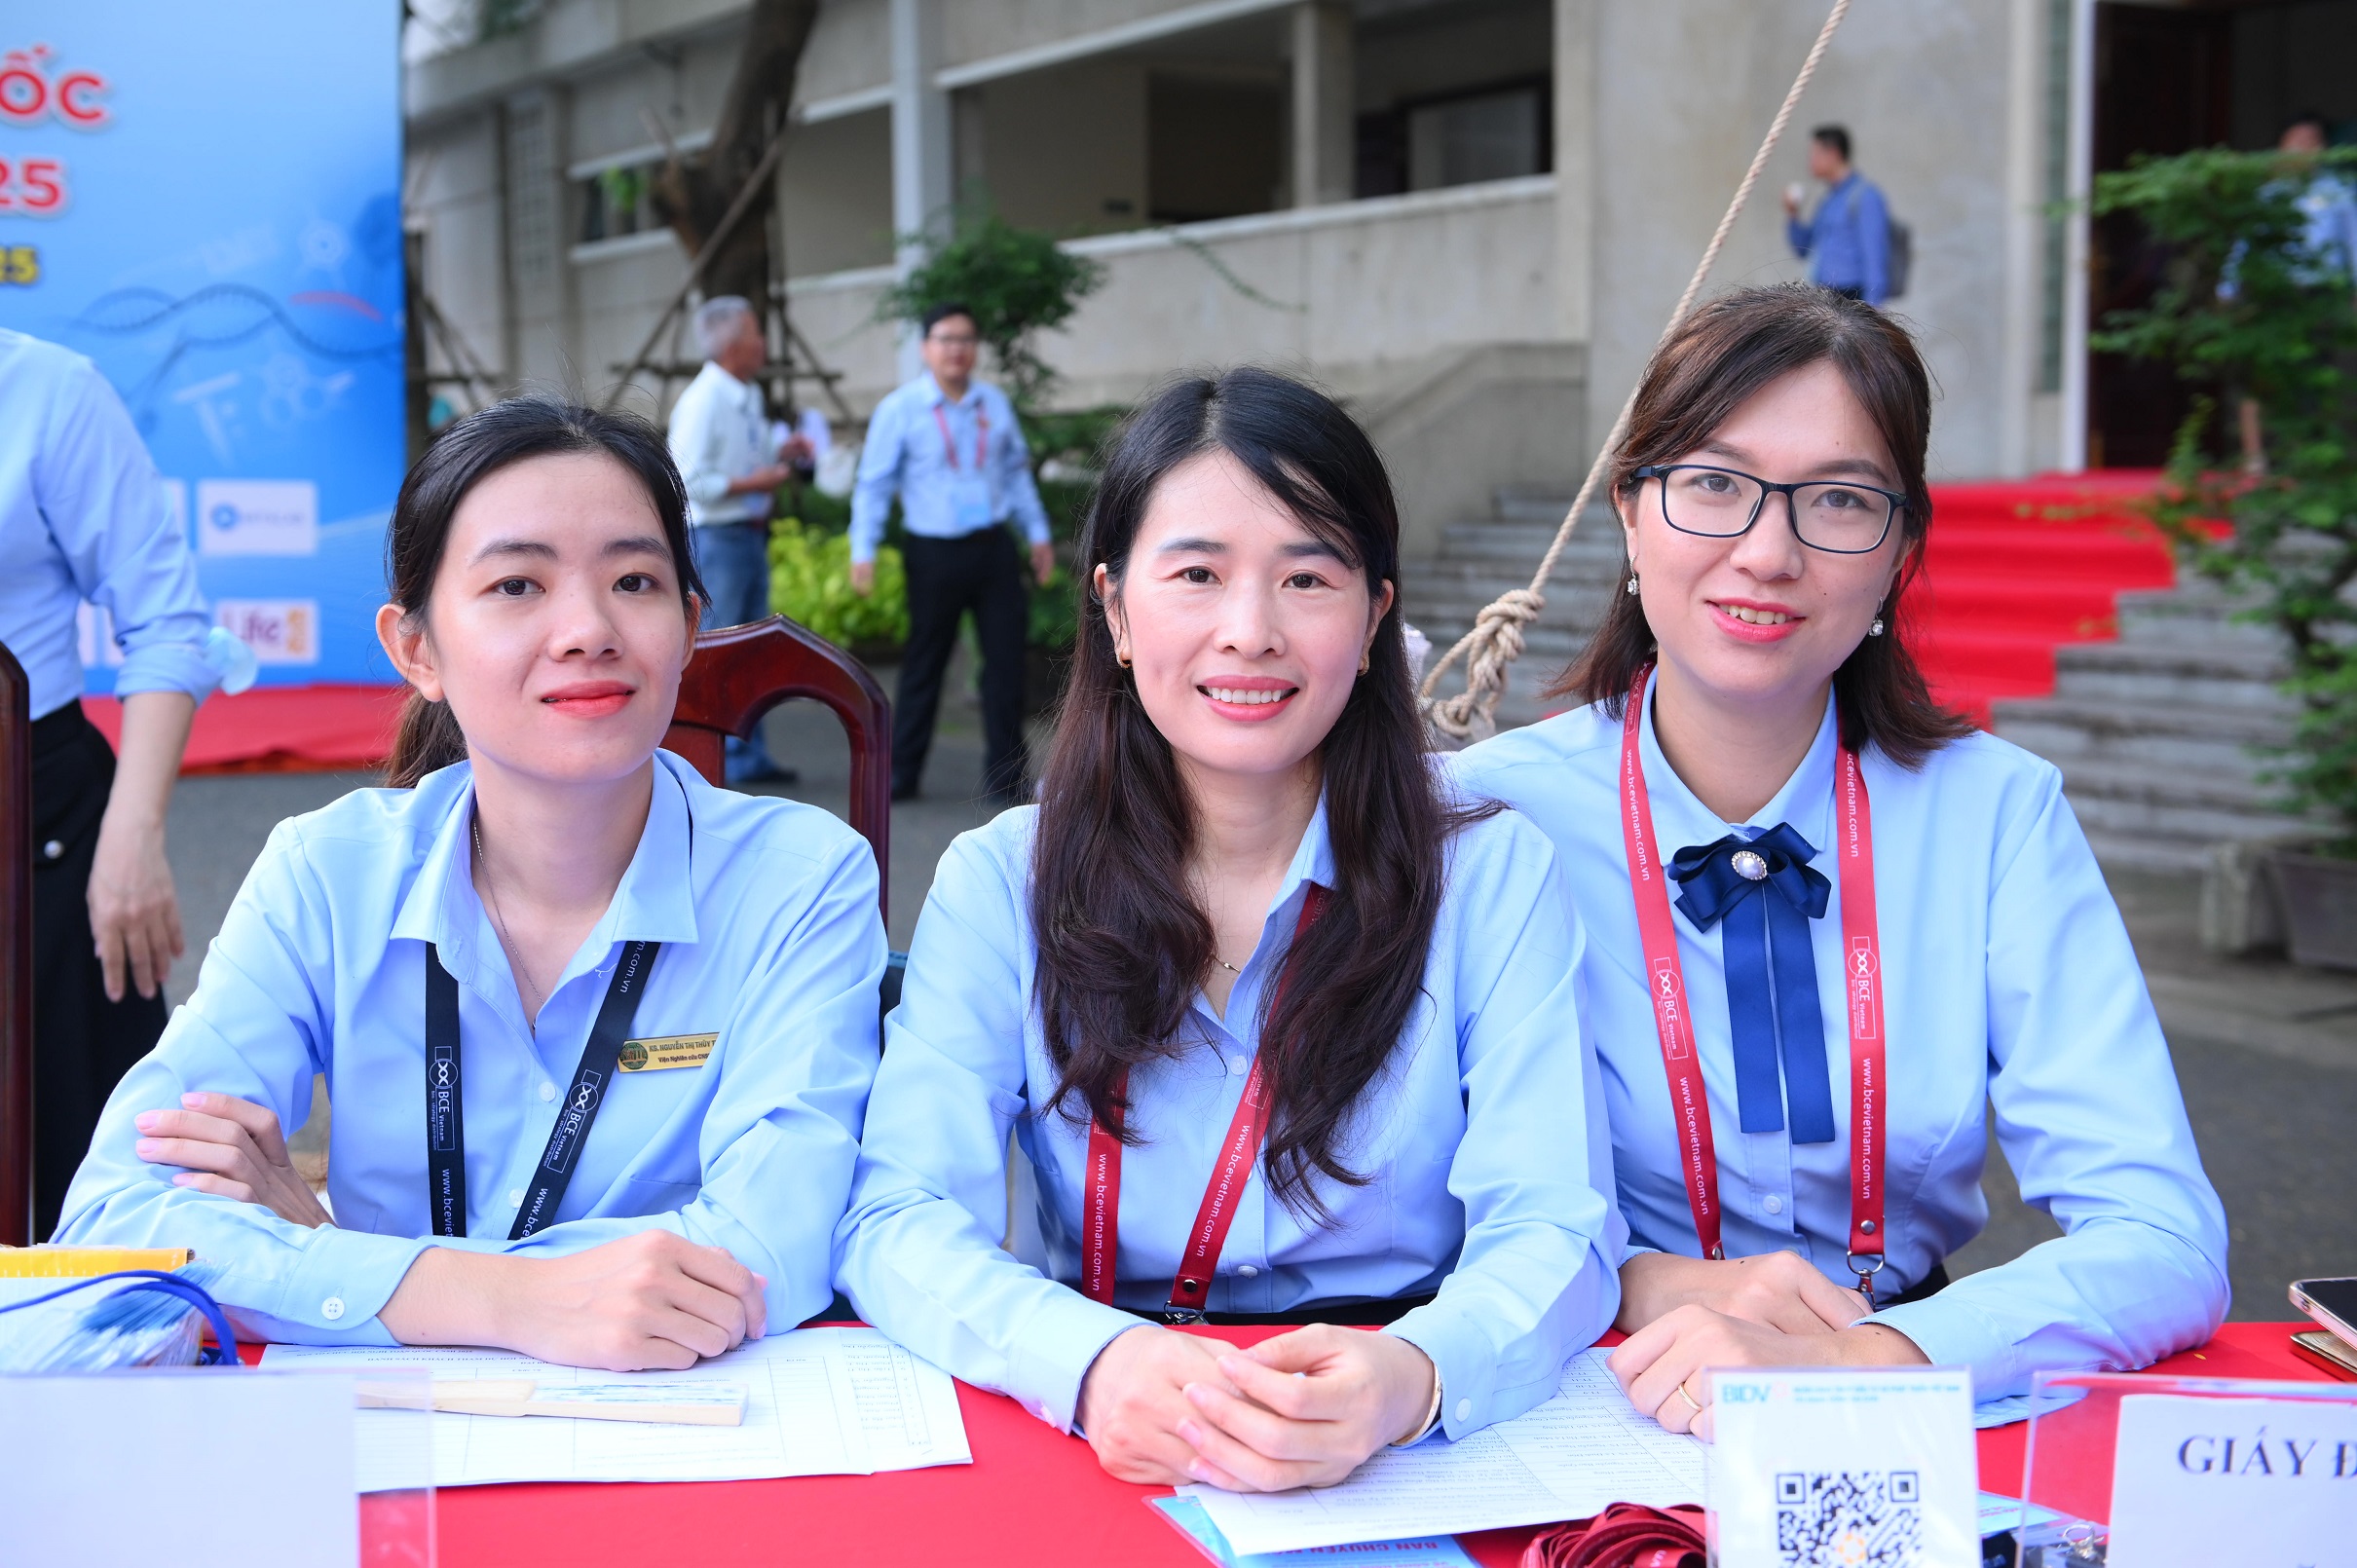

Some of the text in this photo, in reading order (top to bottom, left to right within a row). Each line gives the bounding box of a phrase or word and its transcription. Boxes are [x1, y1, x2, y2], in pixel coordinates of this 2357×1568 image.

[1627, 749, 1650, 881] www.bcevietnam.com.vn
[1664, 1000, 1677, 1023] BCE
[1858, 980, 1871, 1001] BCE
[438, 1091, 450, 1113] BCE
[564, 1112, 580, 1136] BCE
[1679, 1076, 1708, 1215] www.bcevietnam.com.vn
[1862, 1058, 1876, 1200] www.bcevietnam.com.vn
[520, 1188, 548, 1240] www.bce
[1091, 1153, 1107, 1292] www.bcevietnam.com.vn
[1196, 1125, 1252, 1258] www.bcevietnam.com.vn
